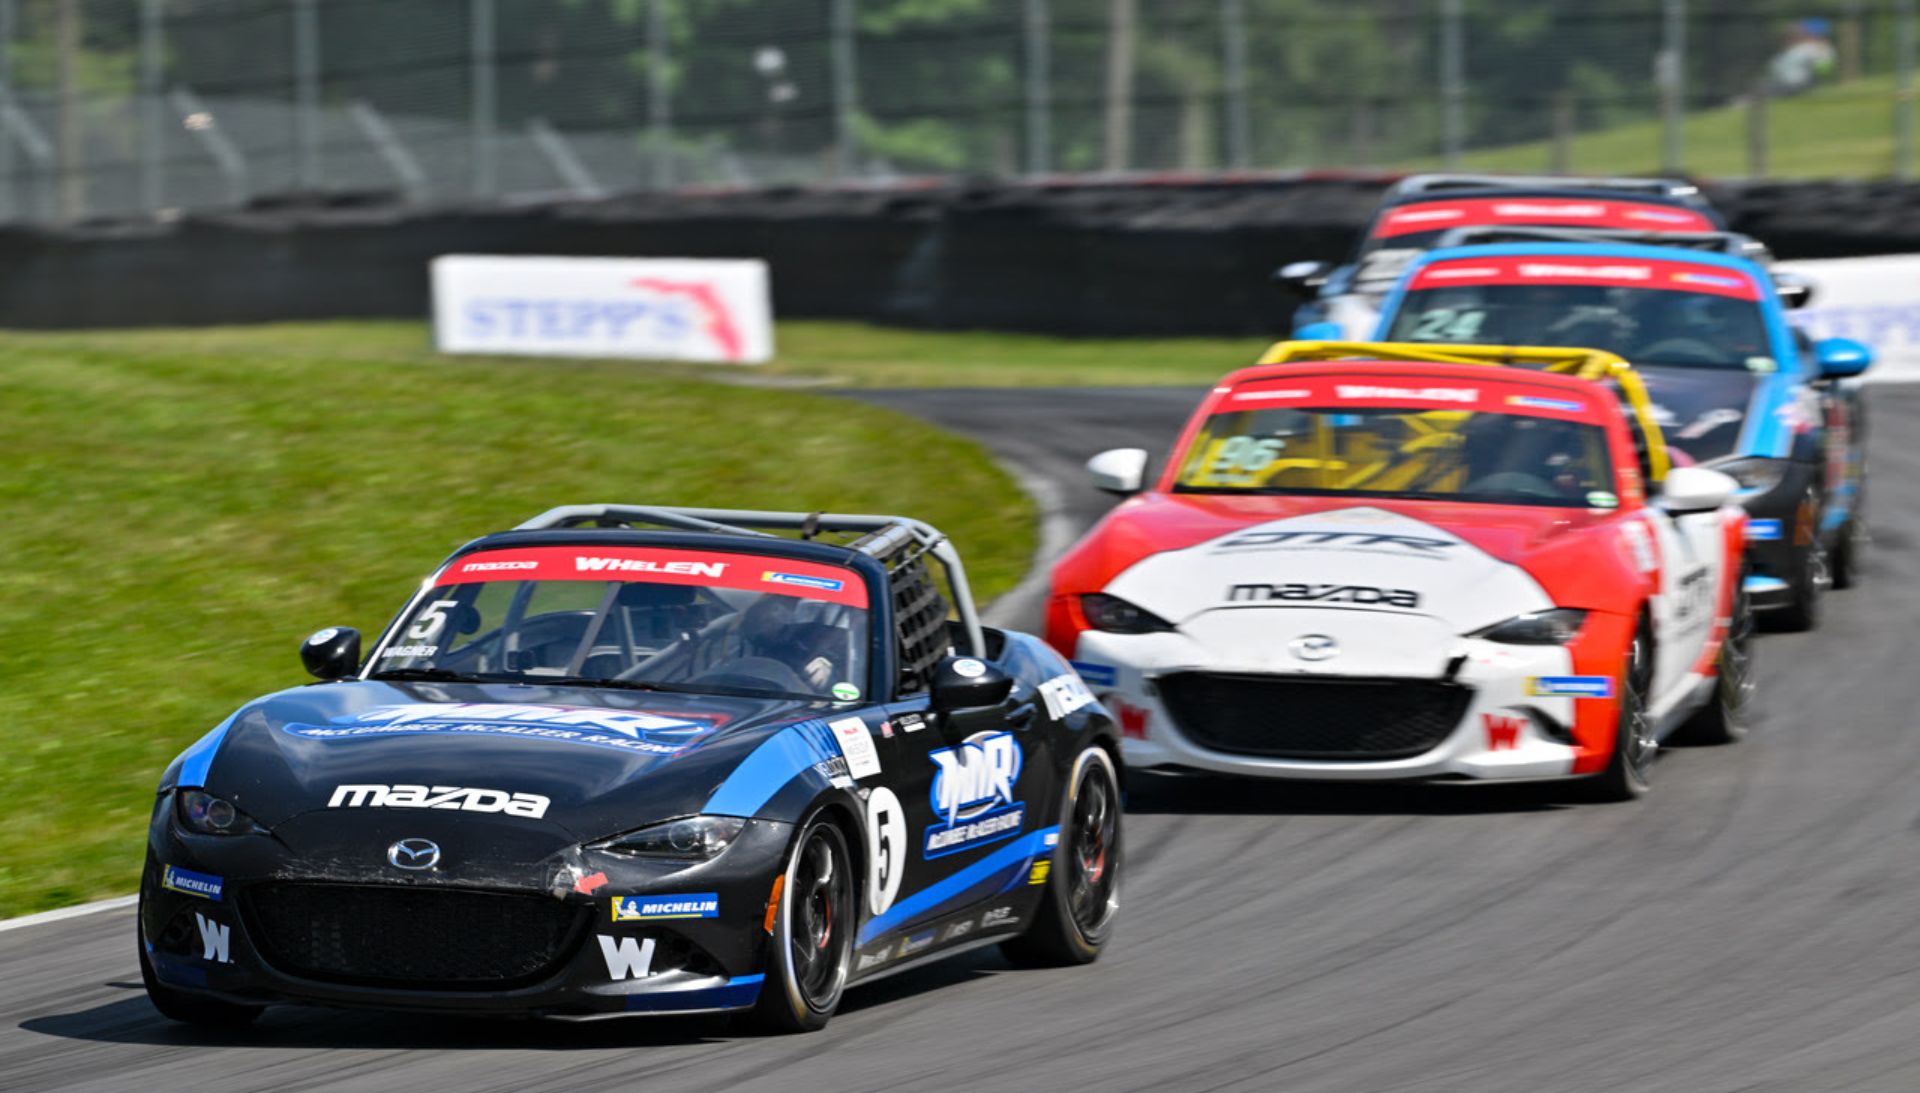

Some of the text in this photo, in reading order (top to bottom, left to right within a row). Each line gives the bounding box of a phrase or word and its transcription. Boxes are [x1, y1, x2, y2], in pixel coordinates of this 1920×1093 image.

[1411, 308, 1488, 340] 24
[1216, 436, 1287, 471] 96
[462, 561, 539, 572] mazda
[575, 557, 723, 578] WHELEN
[1227, 584, 1421, 608] mazda
[408, 601, 458, 639] 5
[381, 645, 439, 658] WAGNER
[327, 784, 551, 820] mazda
[877, 810, 891, 892] 5
[175, 876, 222, 895] MICHELIN
[641, 901, 718, 914] MICHELIN
[597, 934, 656, 980] W
